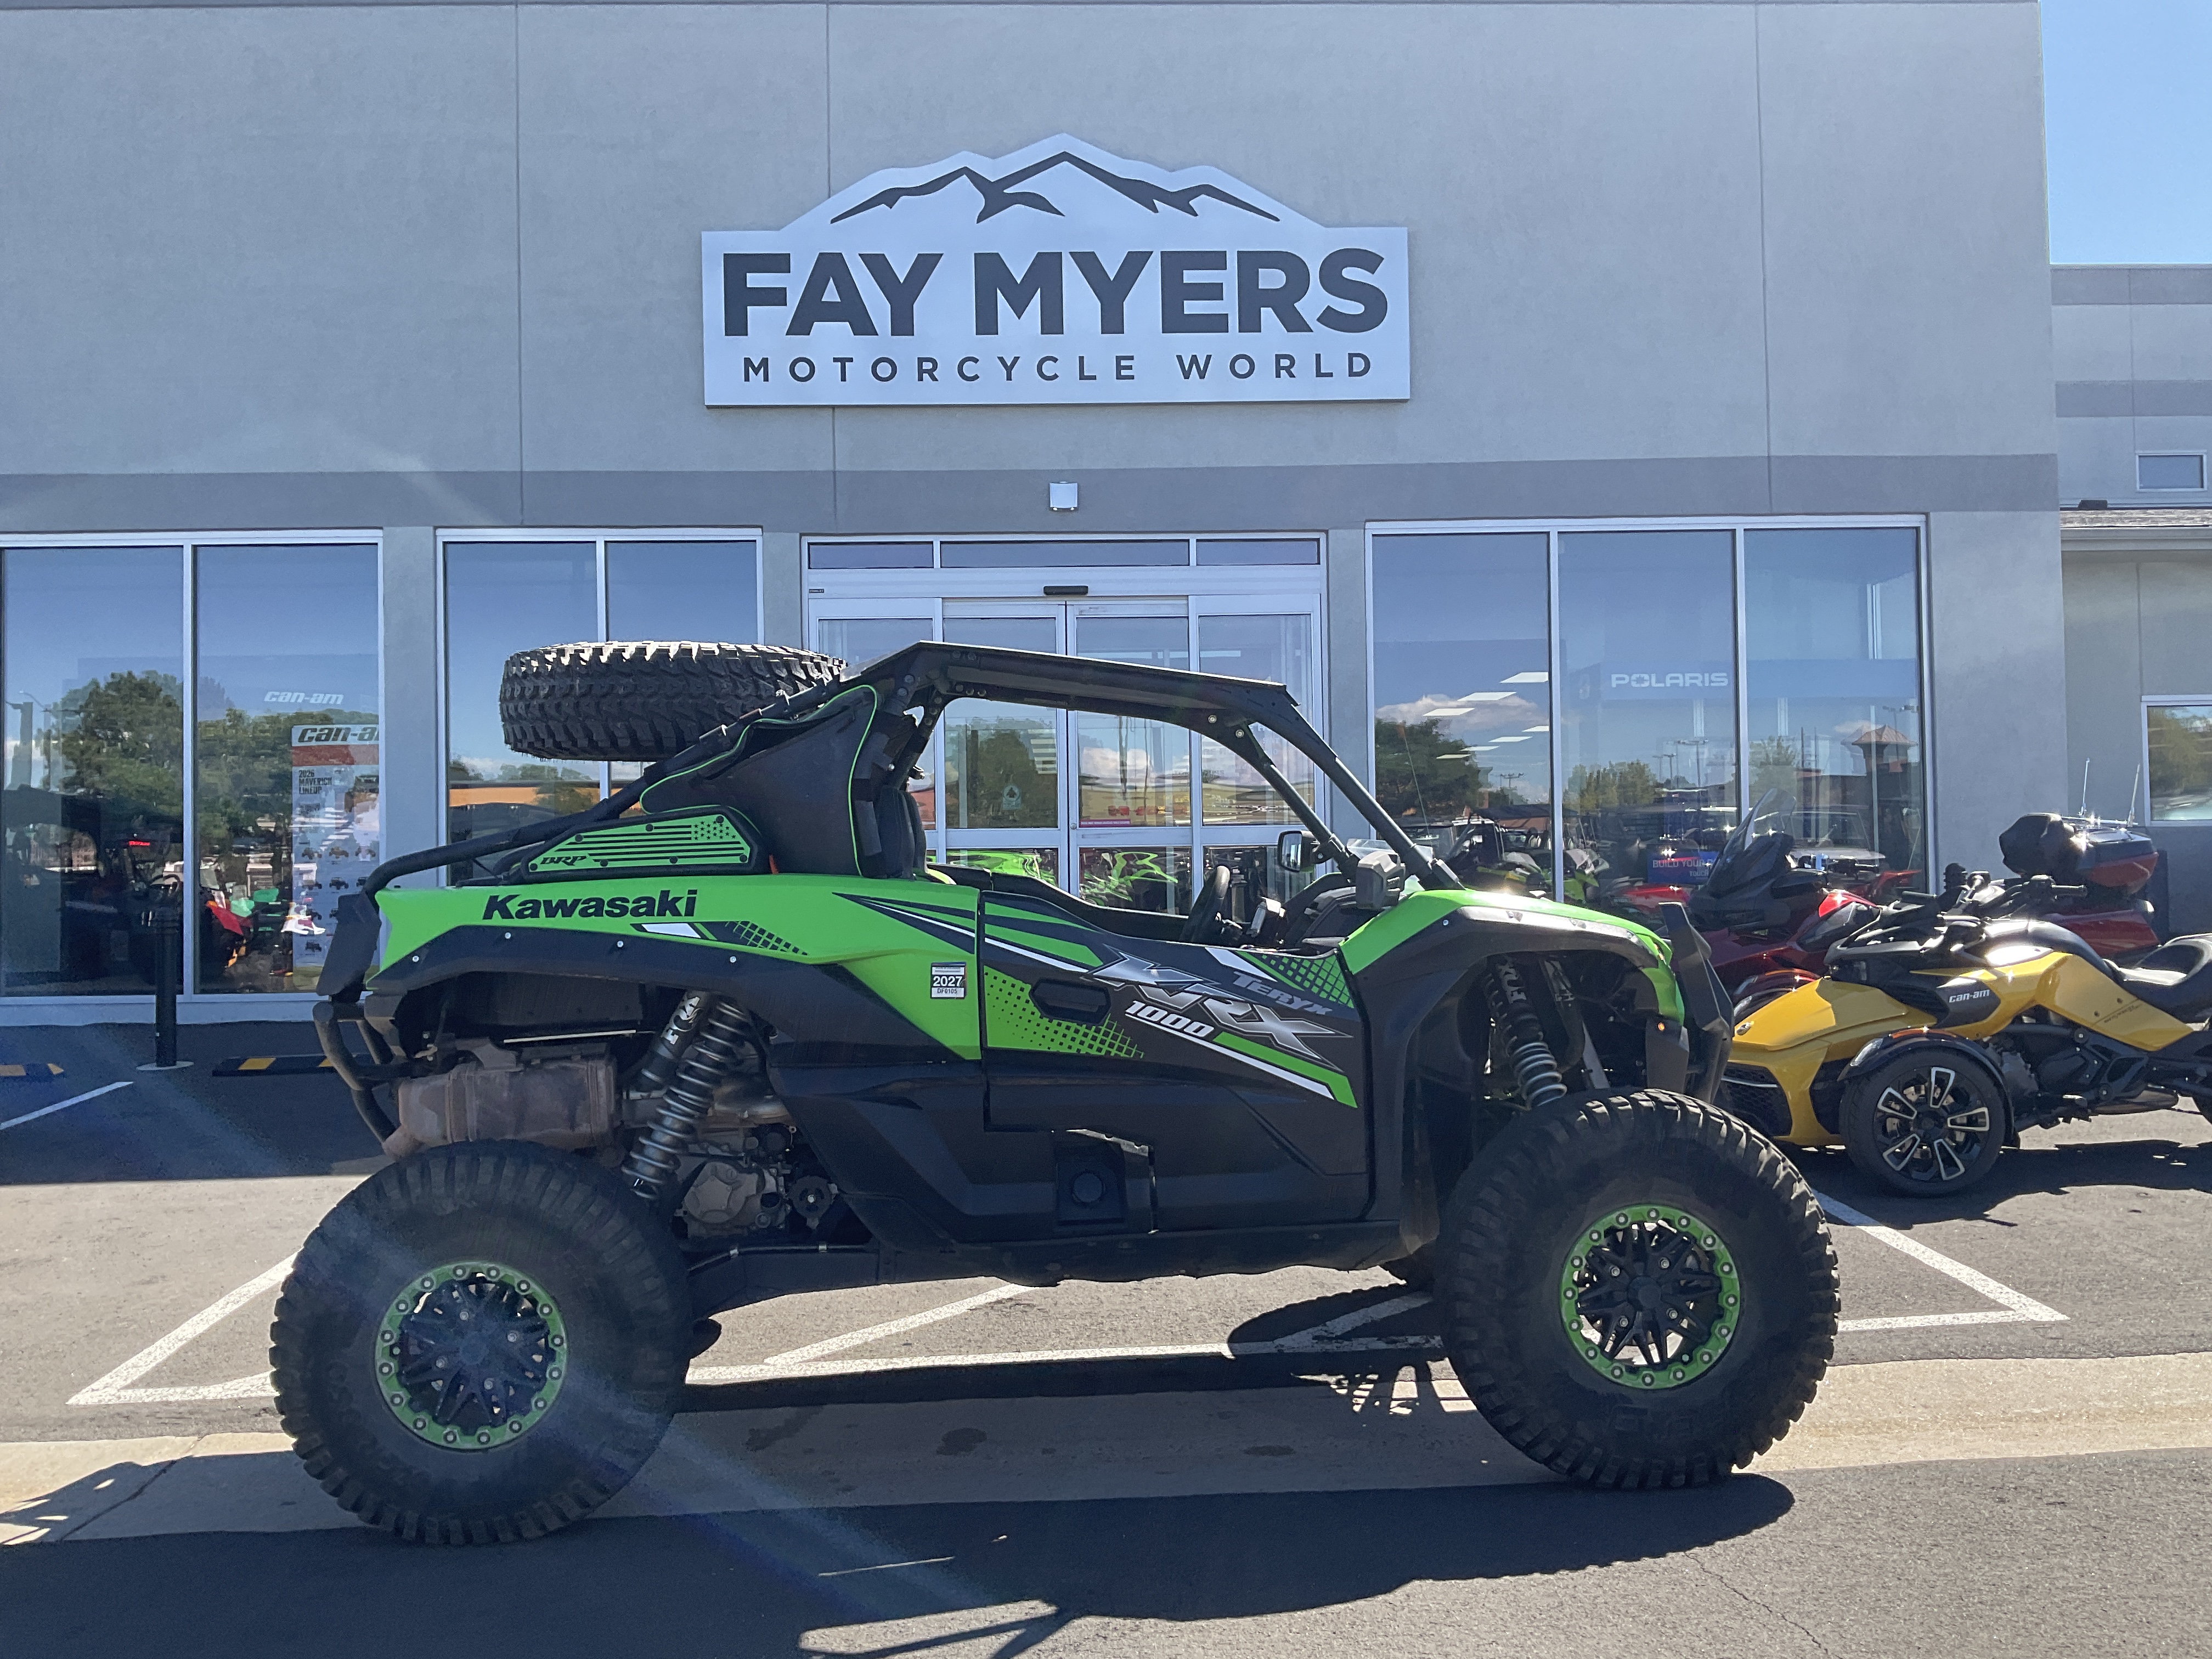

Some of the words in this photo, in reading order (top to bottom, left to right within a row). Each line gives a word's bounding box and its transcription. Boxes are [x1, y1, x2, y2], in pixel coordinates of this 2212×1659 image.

[723, 251, 944, 336] FAY
[974, 247, 1389, 335] MYERS
[743, 354, 1136, 383] MOTORCYCLE
[1176, 352, 1372, 380] WORLD
[1611, 673, 1728, 688] POLARIS
[264, 691, 344, 704] can-am
[298, 726, 379, 743] can-a
[298, 770, 314, 778] 2026
[298, 777, 332, 786] MAVERICK
[298, 786, 322, 794] LINEUP
[1652, 860, 1679, 868] BUILD
[1681, 859, 1704, 867] YOUR
[482, 889, 697, 921] Kawasaki
[933, 975, 963, 987] 2027
[1949, 989, 1990, 1003] can-am
[1125, 1000, 1215, 1037] 1000
